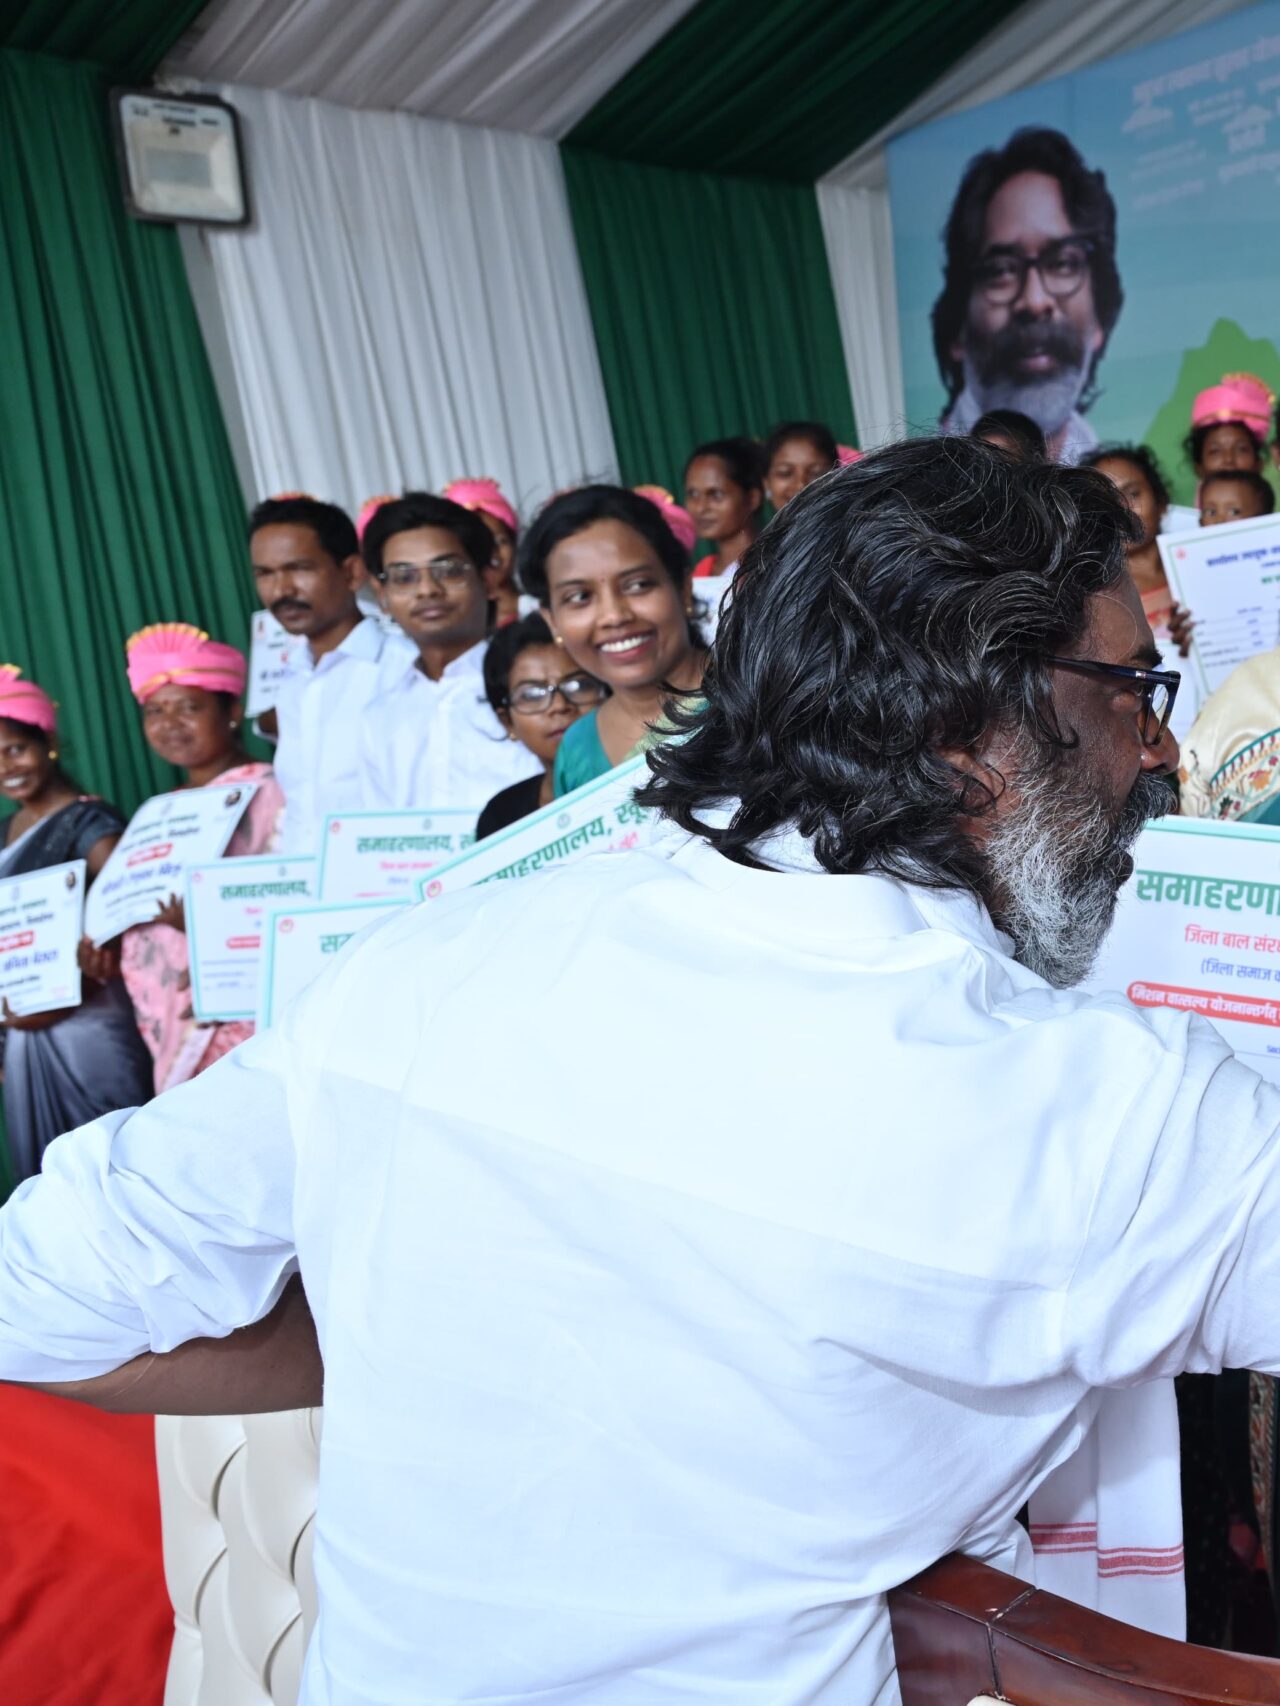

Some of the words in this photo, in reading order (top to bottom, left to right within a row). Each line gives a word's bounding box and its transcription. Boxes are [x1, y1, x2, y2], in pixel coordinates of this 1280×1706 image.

[1184, 923, 1219, 947] जिला
[1221, 930, 1250, 951] बाल
[1200, 958, 1235, 978] (जिला
[1236, 962, 1272, 982] समाज
